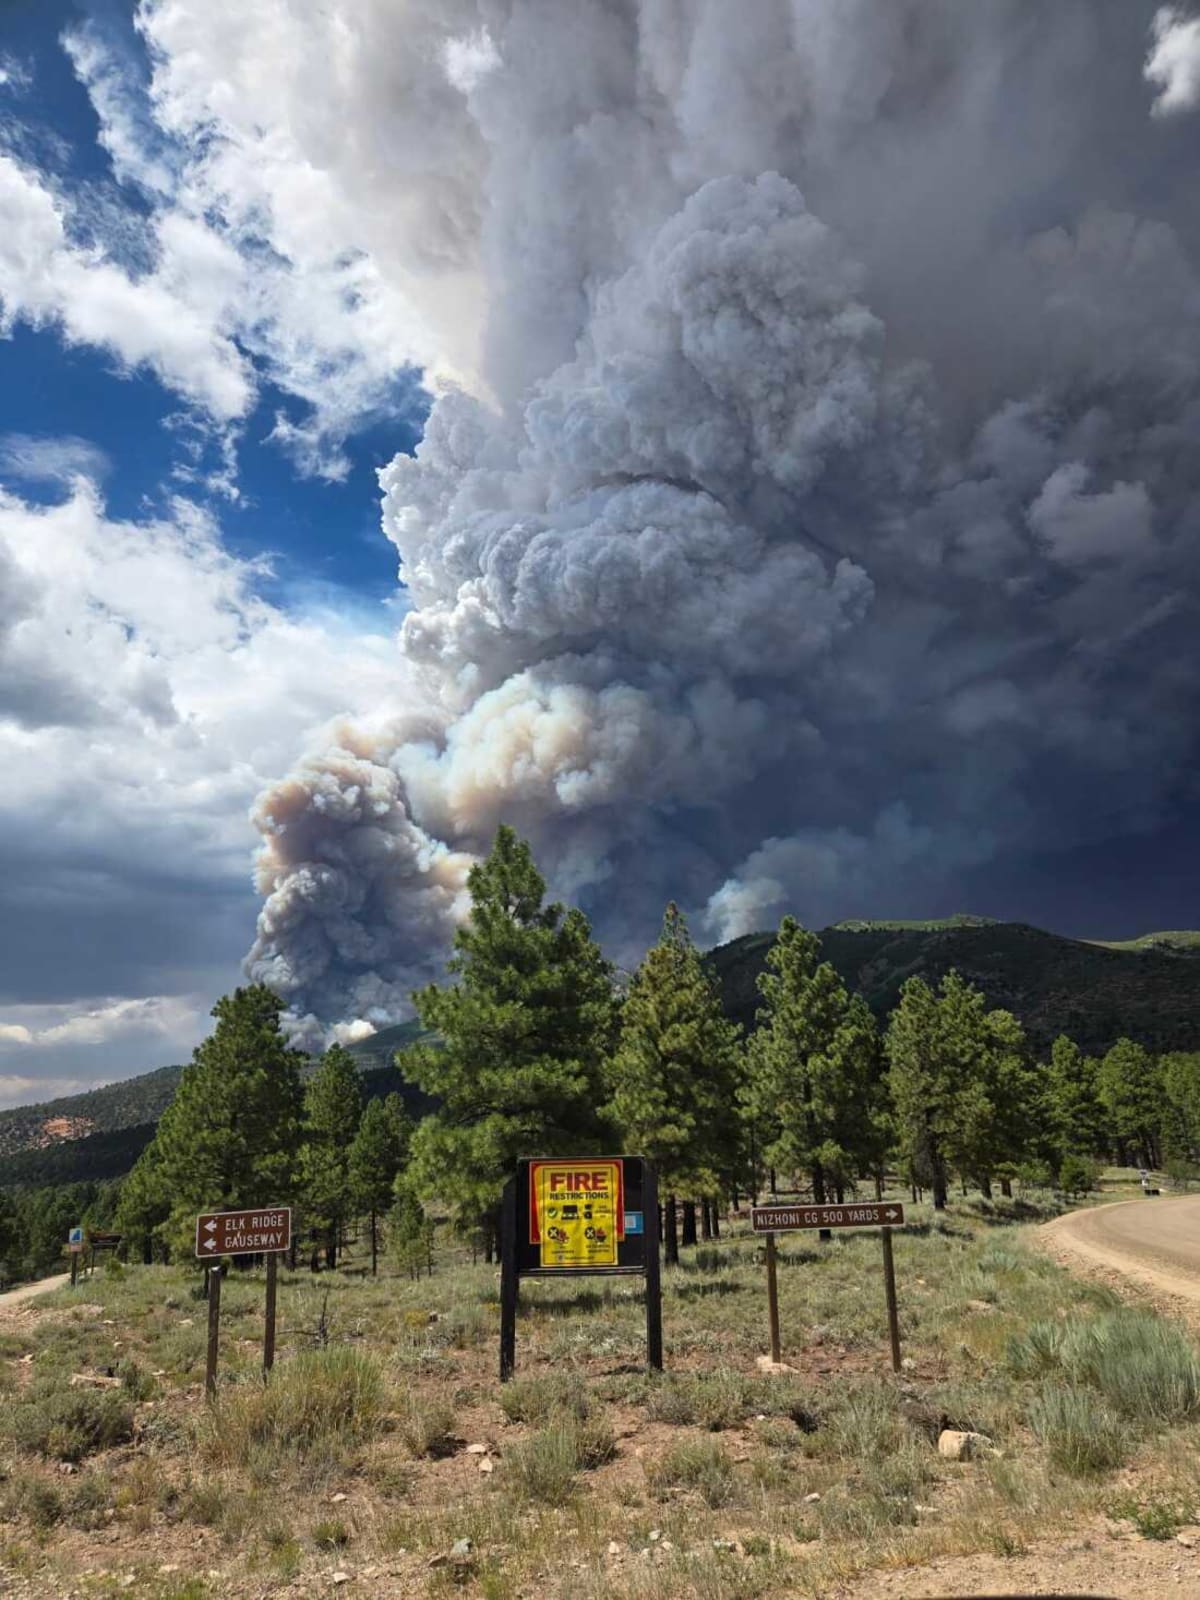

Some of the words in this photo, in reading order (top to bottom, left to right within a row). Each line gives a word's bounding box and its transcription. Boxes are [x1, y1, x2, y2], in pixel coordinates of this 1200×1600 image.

[550, 1171, 608, 1191] FIRE
[550, 1192, 609, 1200] RESTRICTIONS
[225, 1218, 245, 1231] ELK
[252, 1214, 285, 1229] RIDGE
[756, 1213, 800, 1225] NIZHONI
[804, 1212, 818, 1224] CG
[823, 1211, 843, 1223] 500
[848, 1209, 879, 1221] YARDS
[225, 1232, 283, 1249] CAUSEWAY
